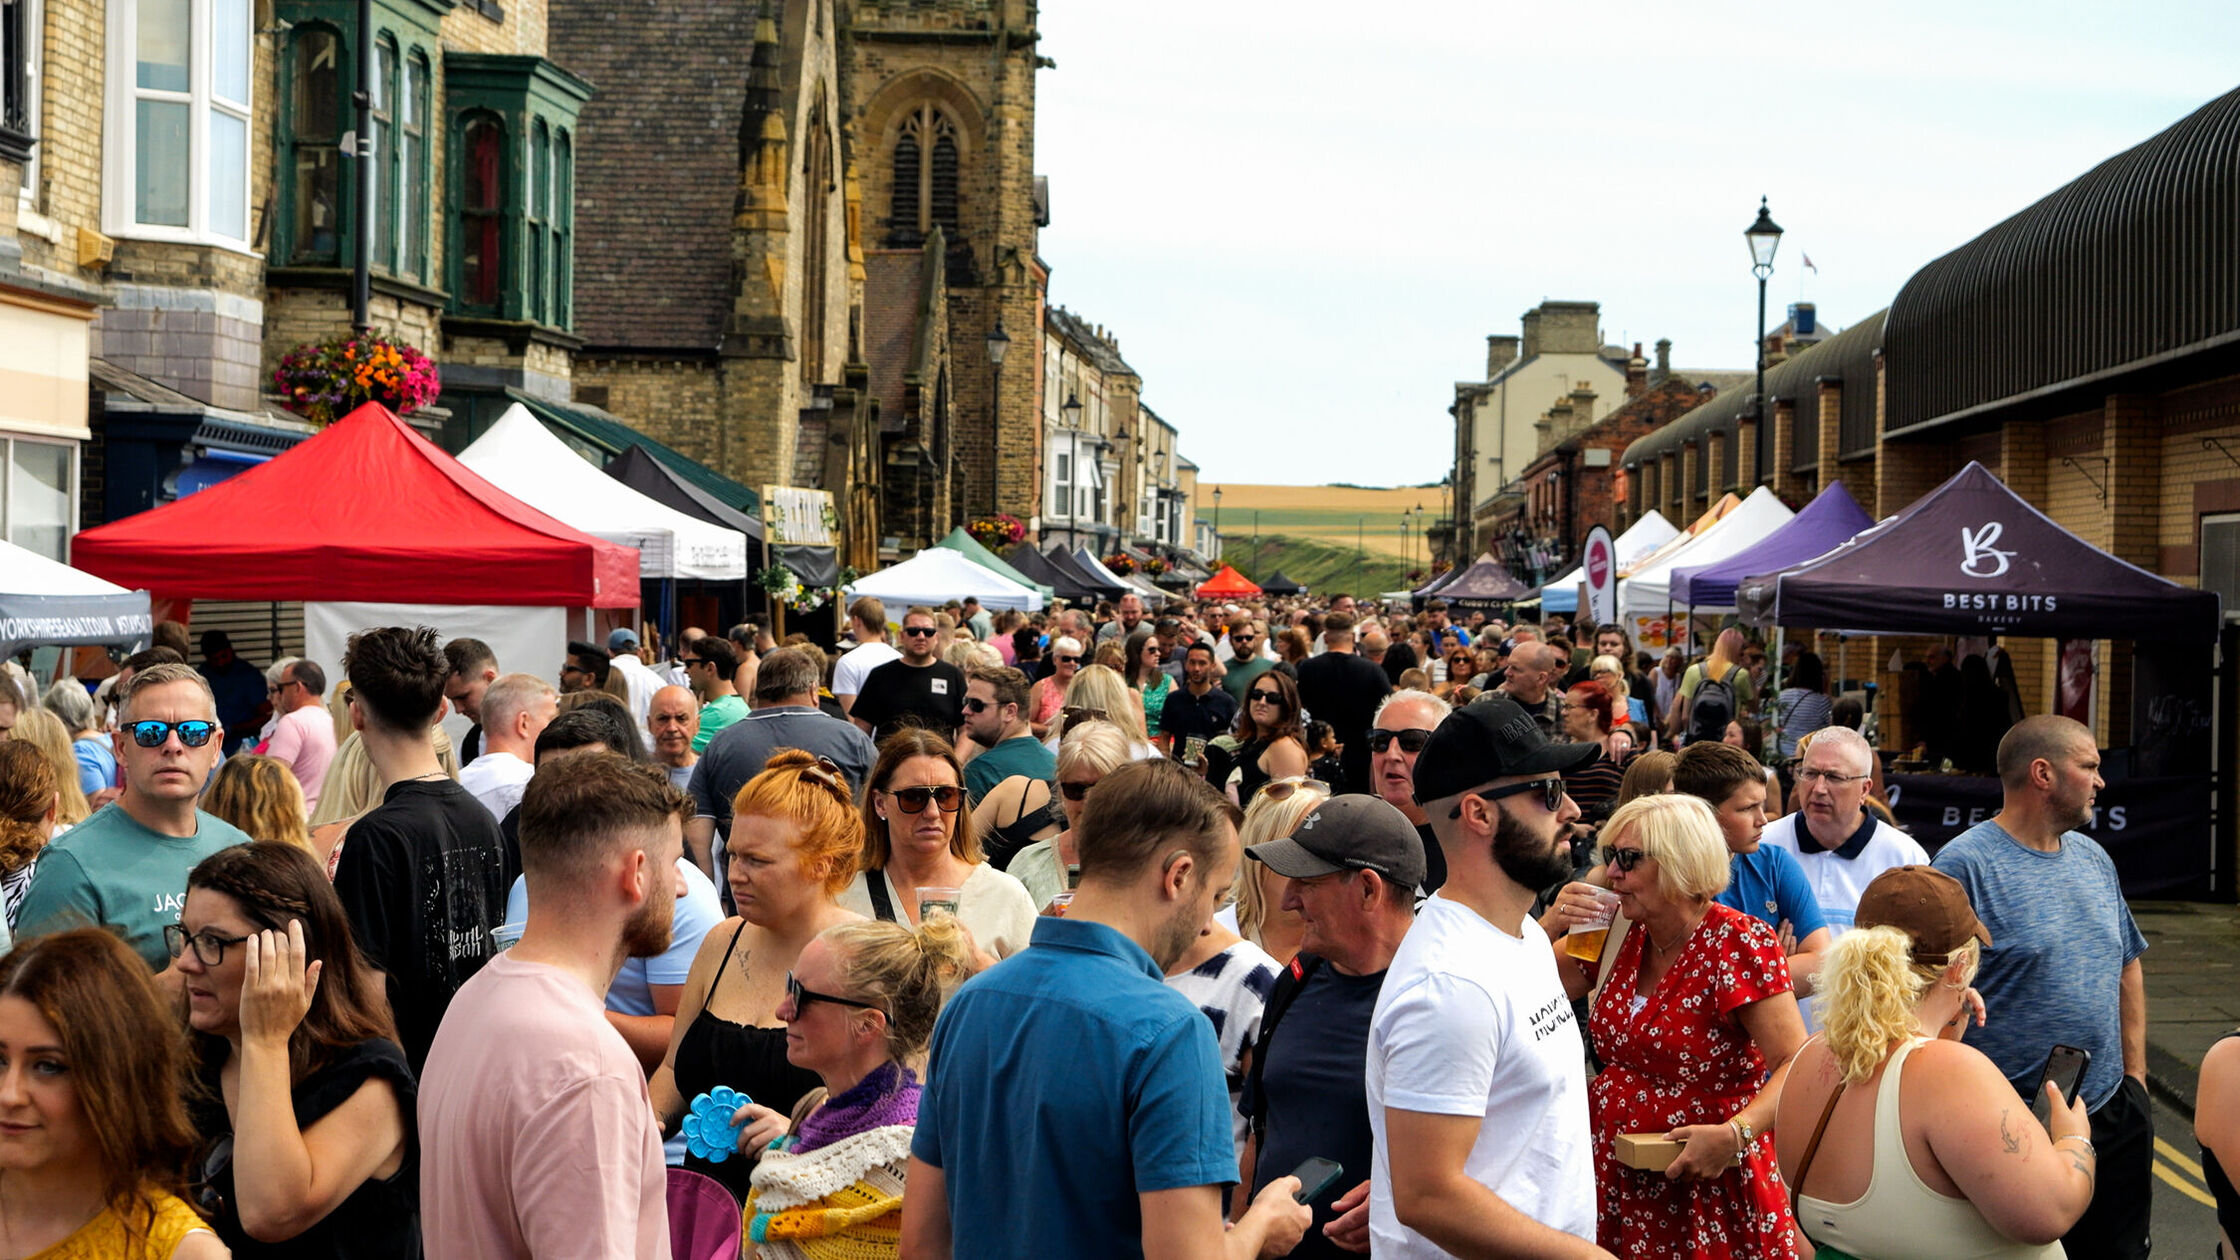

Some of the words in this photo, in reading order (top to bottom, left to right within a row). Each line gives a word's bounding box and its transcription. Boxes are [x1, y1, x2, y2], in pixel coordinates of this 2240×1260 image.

[1943, 593, 2000, 610] BEST
[2006, 594, 2057, 612] BITS
[1942, 806, 2000, 826] BE
[153, 892, 187, 912] JAC
